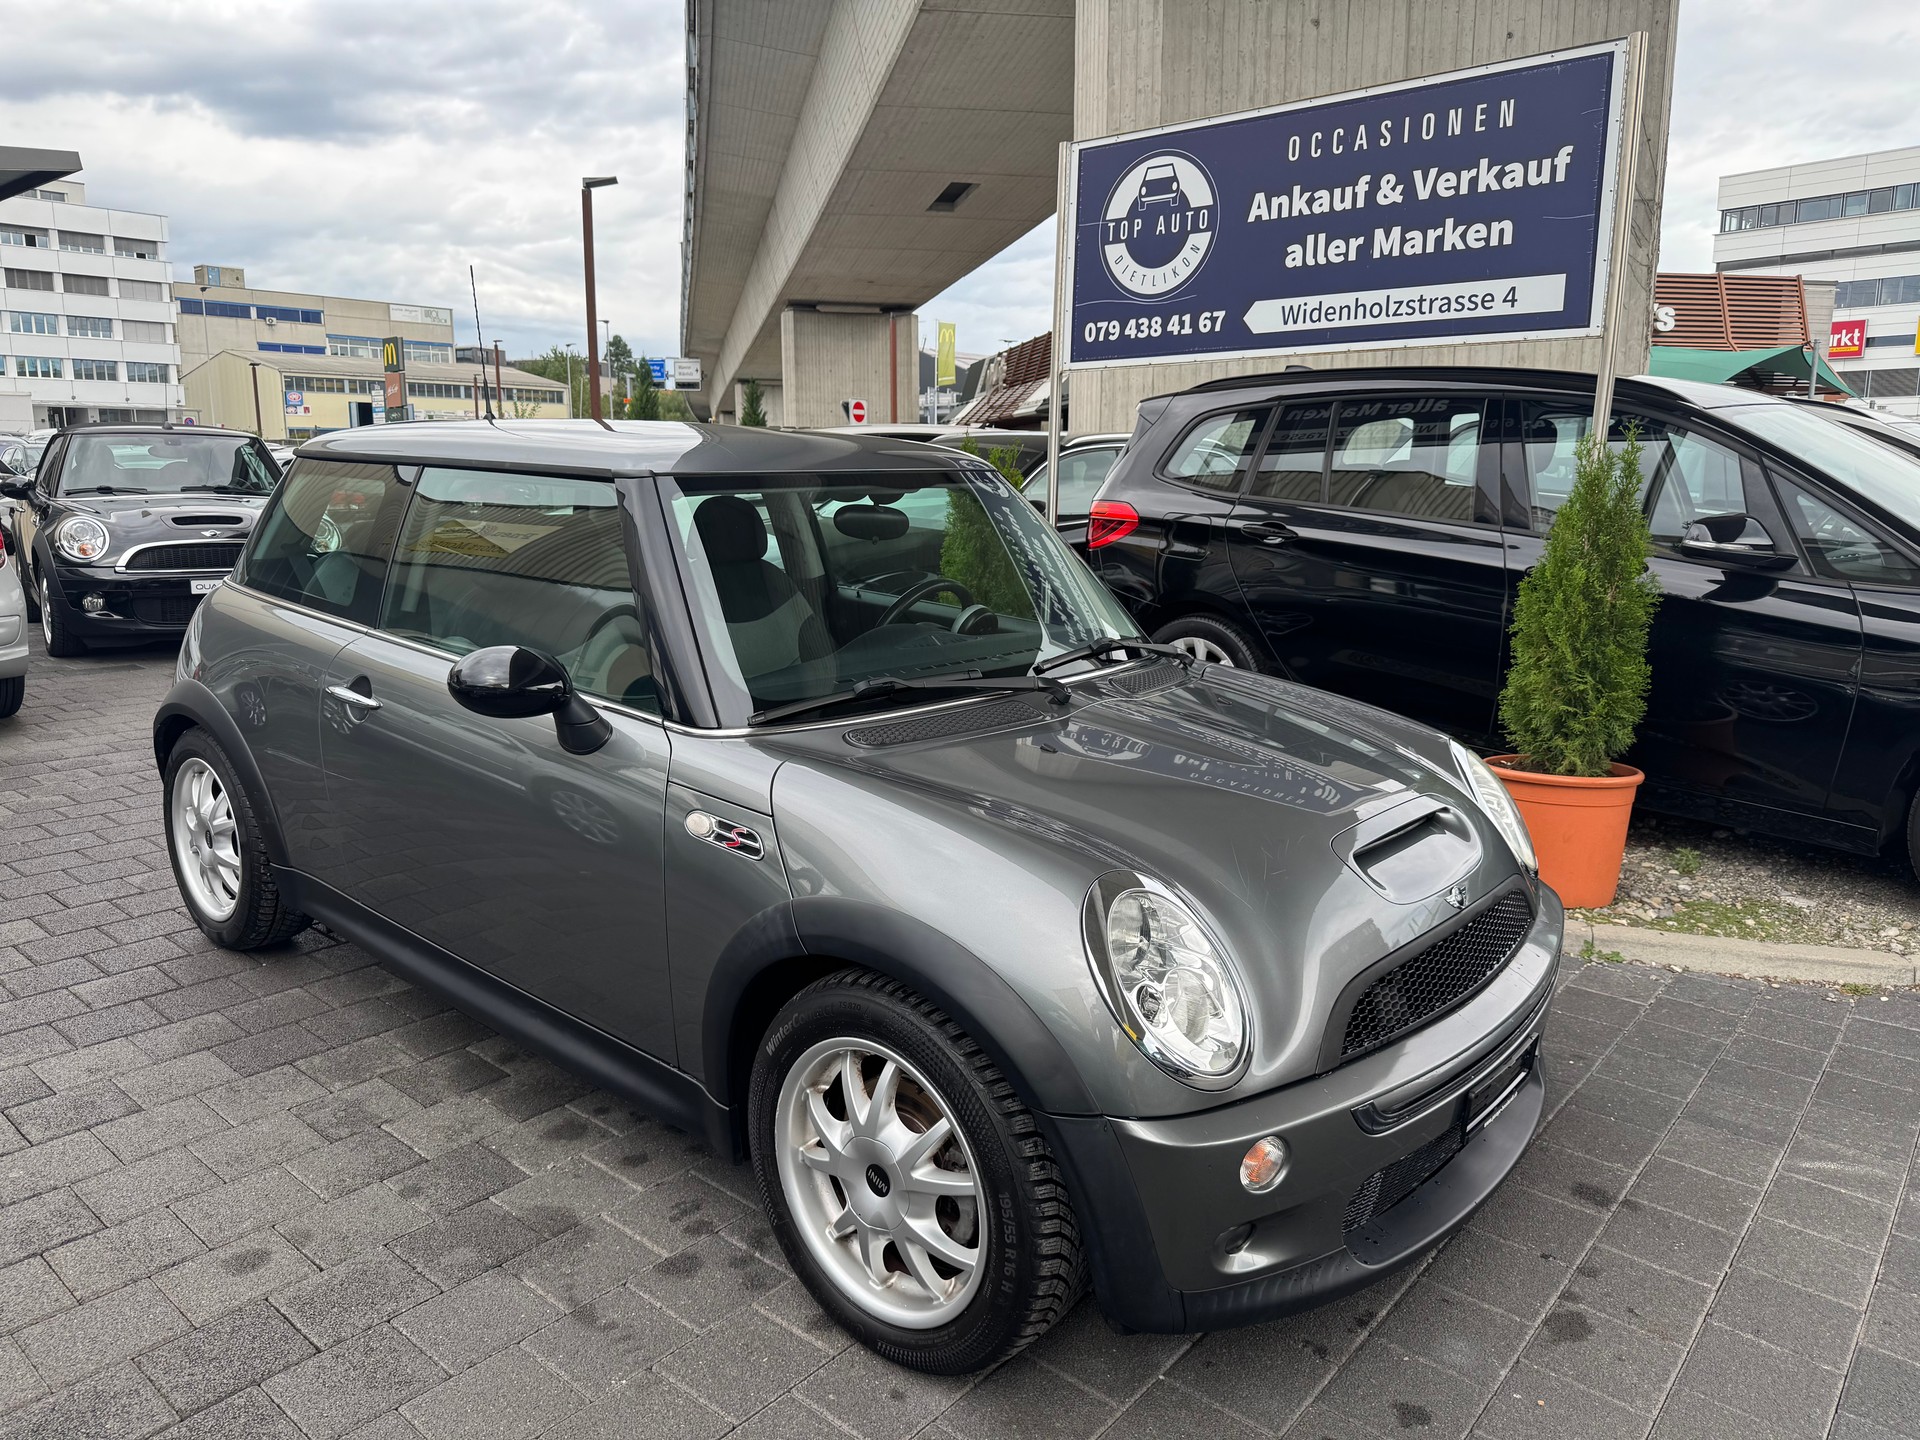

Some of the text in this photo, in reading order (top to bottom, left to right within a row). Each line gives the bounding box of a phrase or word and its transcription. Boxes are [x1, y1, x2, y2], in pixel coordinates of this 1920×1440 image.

[1288, 98, 1515, 162] OCCASIONEN
[1247, 145, 1574, 223] Ankauf & Verkauf
[1108, 209, 1209, 241] TOP AUTO
[1284, 217, 1513, 269] aller Marken
[1114, 244, 1201, 288] DIETLIKON
[1281, 286, 1518, 326] Widenholzstrasse 4
[1084, 310, 1226, 343] 079 438 41 67
[724, 827, 747, 847] S
[867, 1168, 888, 1194] MINI
[999, 1191, 1017, 1244] 195/55
[1003, 1262, 1016, 1278] 16
[1004, 1248, 1017, 1259] R
